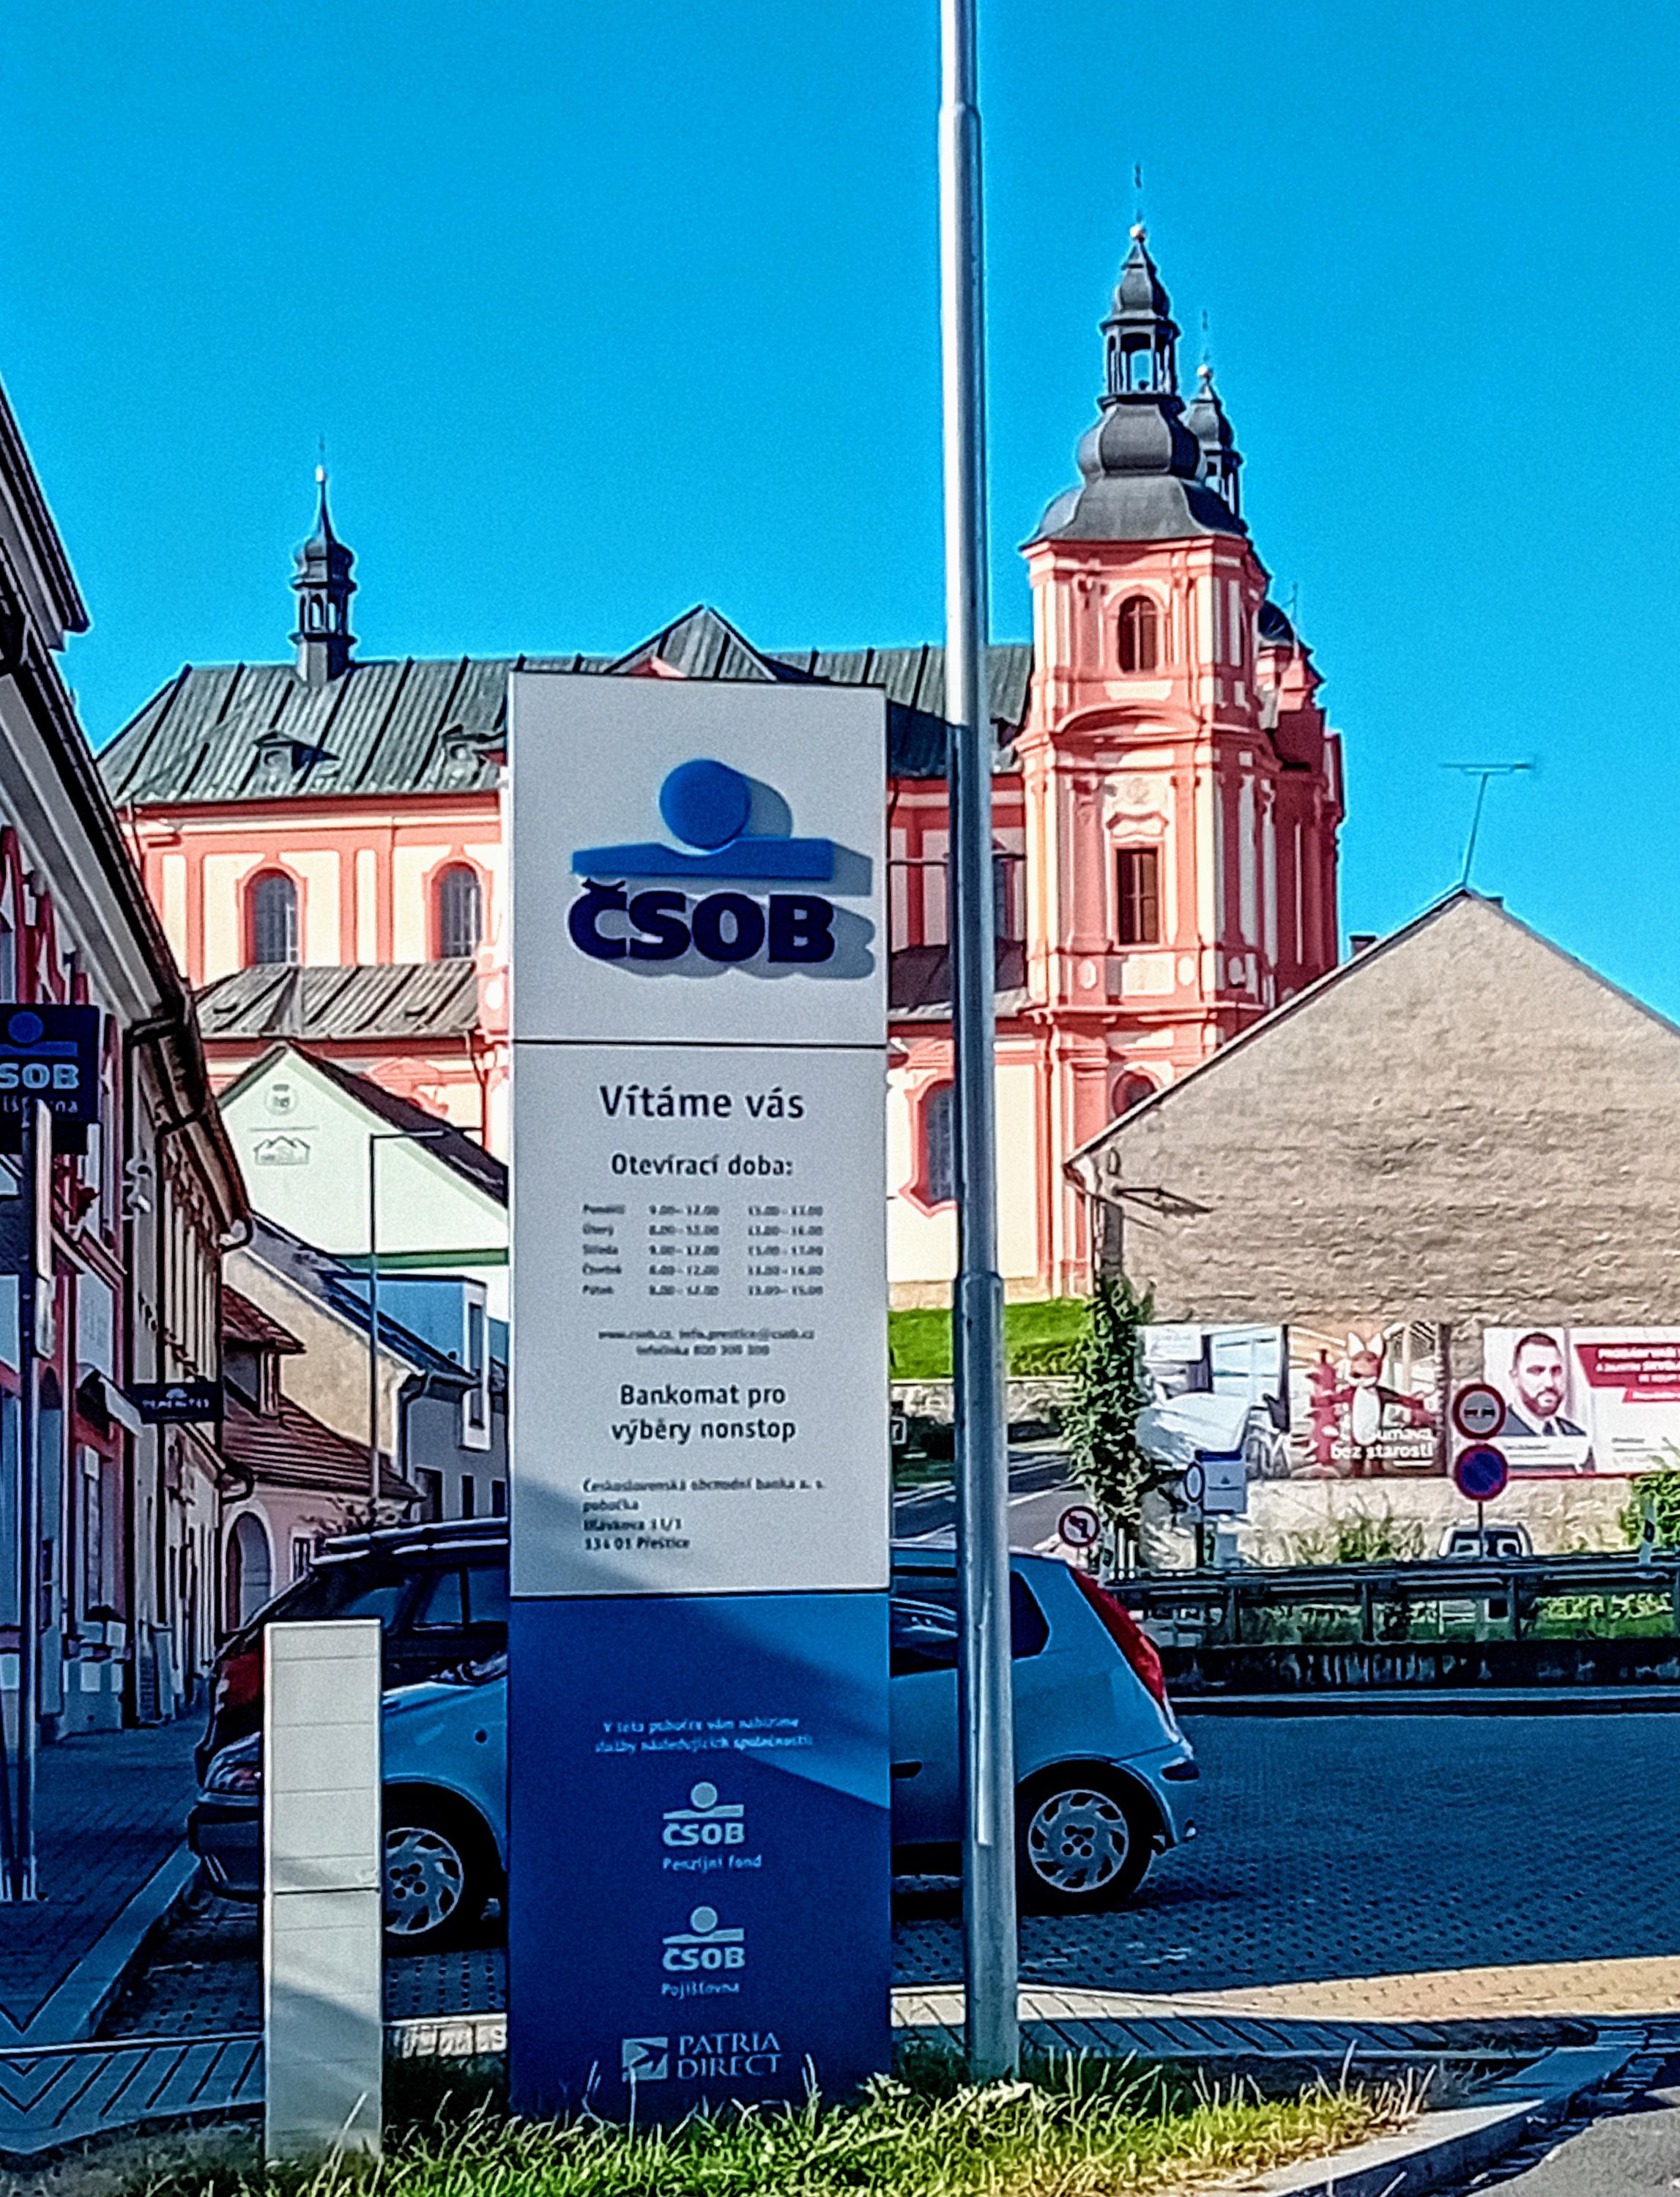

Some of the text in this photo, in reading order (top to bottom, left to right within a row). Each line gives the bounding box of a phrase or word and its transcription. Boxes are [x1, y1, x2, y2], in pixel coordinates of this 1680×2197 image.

[569, 878, 835, 963] ČSOB
[0, 1063, 79, 1090] SOB
[600, 1085, 804, 1119] Vítáme vás
[611, 1153, 793, 1177] Otevírací doba:
[621, 1384, 787, 1409] Bankomat pro
[611, 1417, 796, 1446] výběry nonstop
[1330, 1443, 1363, 1460] bez
[662, 1822, 746, 1847] ČSOB
[729, 1854, 762, 1868] fond
[662, 1946, 746, 1971] ČSOB
[679, 2032, 781, 2056] PATRIA
[677, 2054, 782, 2080] DIRECT
